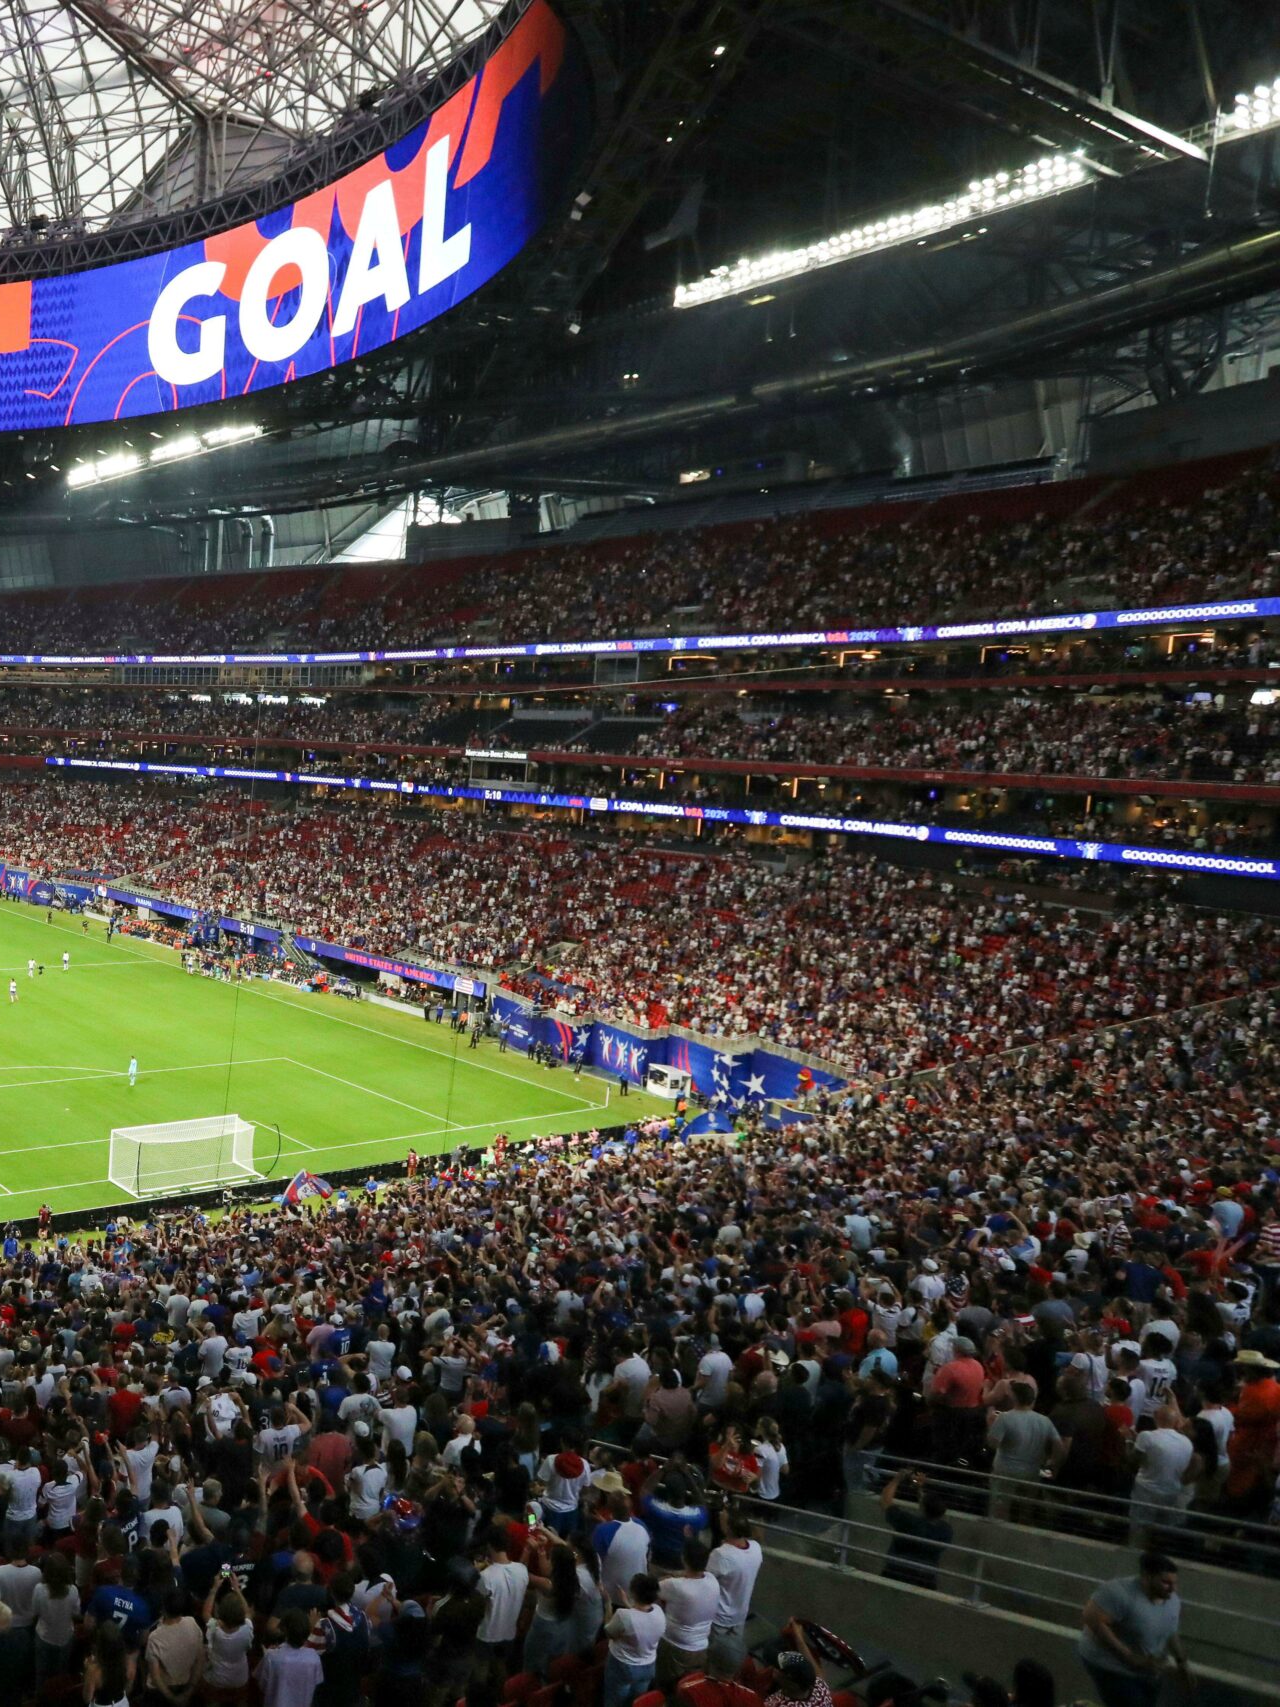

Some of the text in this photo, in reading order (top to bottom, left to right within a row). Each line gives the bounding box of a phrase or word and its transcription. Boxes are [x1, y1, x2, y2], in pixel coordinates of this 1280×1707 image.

[148, 134, 472, 386] GOAL
[936, 616, 1081, 639] CONMEBOL COPA AMERICA
[698, 636, 750, 648] CONMEBOL
[751, 635, 778, 646] COPA
[778, 633, 825, 644] AMERICA
[849, 630, 879, 642] 2024
[581, 642, 617, 652] AMERICA
[485, 790, 502, 800] 5:10
[621, 802, 643, 812] COPA
[643, 804, 684, 816] AMERICA
[780, 814, 917, 838] CONMEBOL COPA AMERICA
[135, 897, 152, 908] PANAMA
[240, 923, 254, 935] 5:10
[311, 942, 316, 951] 0
[344, 952, 436, 983] UNITED STATES OF AMERICA
[113, 1597, 134, 1611] REYNA
